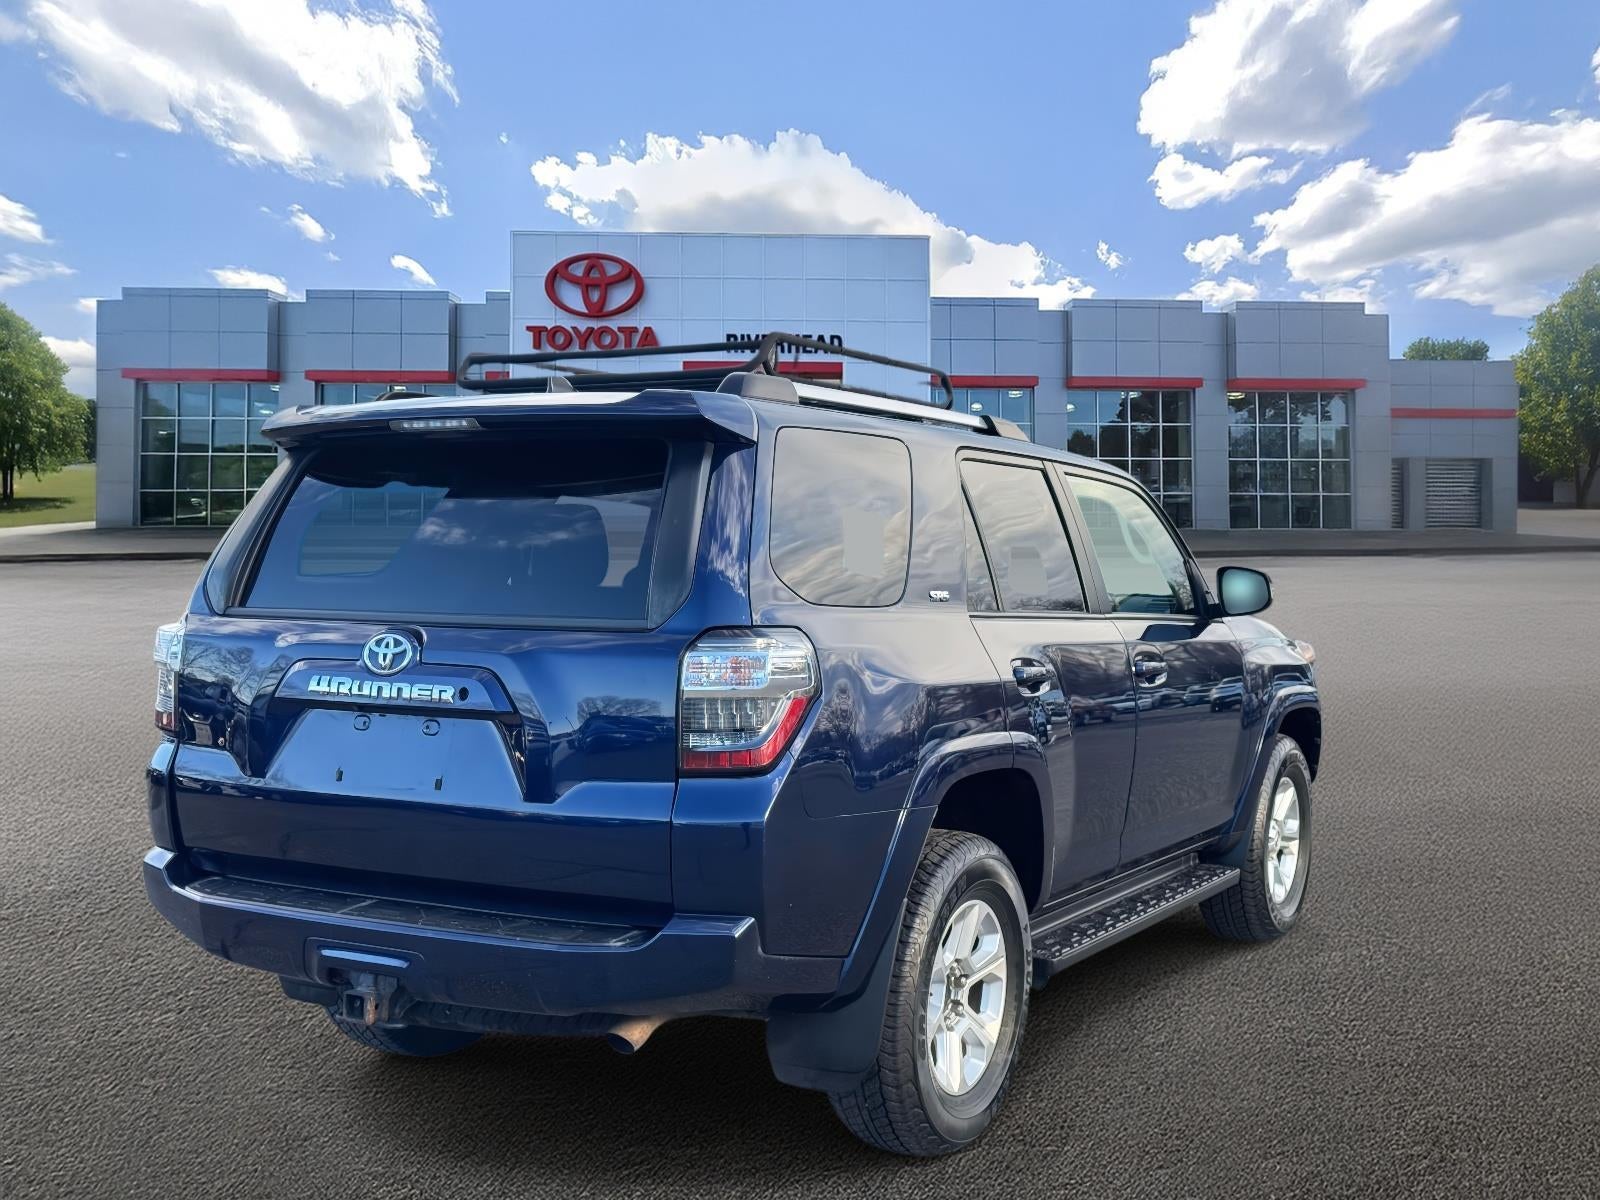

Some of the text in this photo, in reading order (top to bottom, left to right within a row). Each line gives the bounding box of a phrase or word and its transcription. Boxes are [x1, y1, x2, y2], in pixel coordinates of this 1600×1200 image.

[526, 325, 659, 351] TOYOTA
[726, 333, 843, 354] RIVHEAD
[307, 675, 456, 703] 4RUNNER
